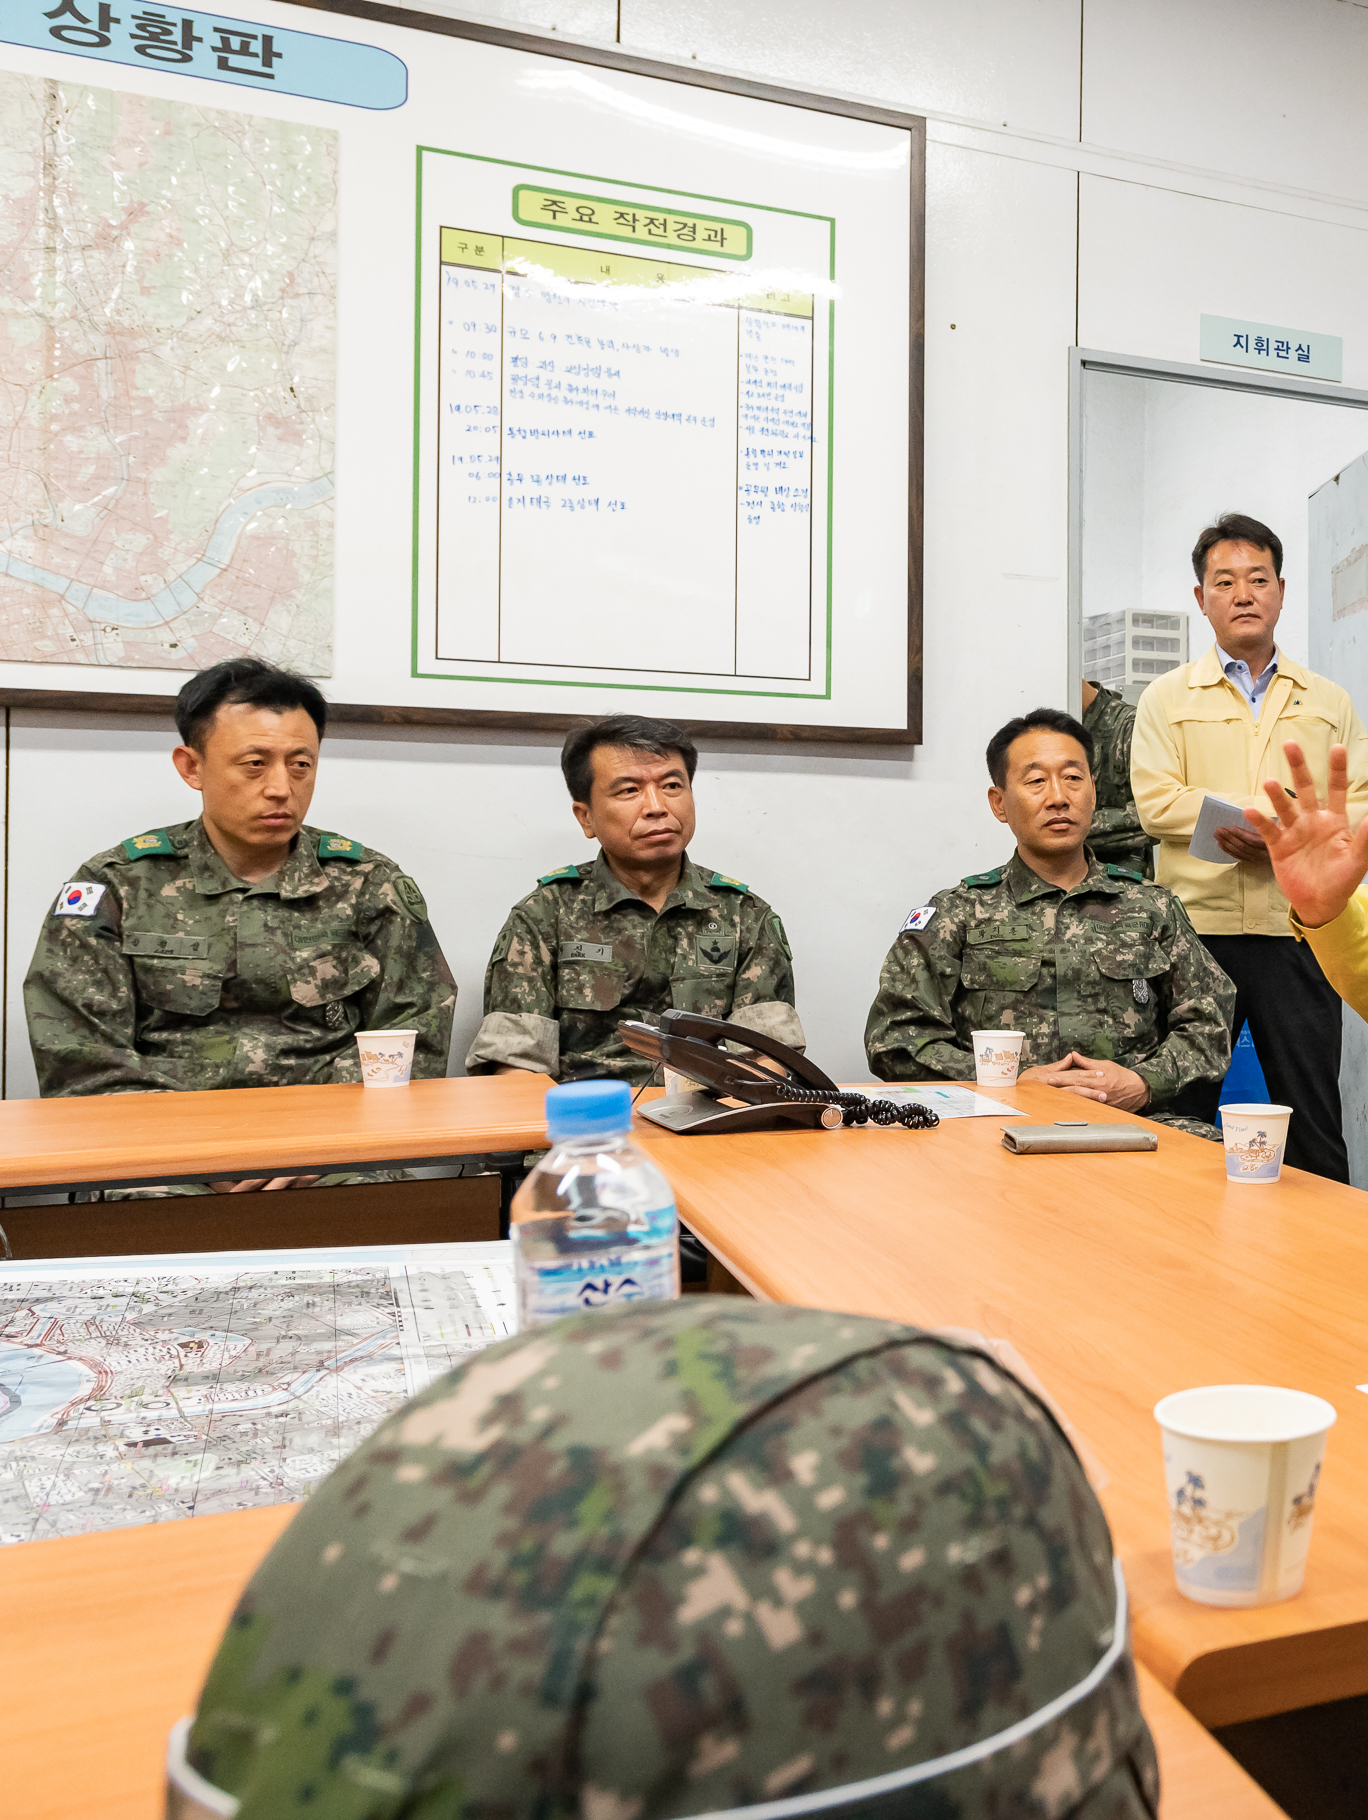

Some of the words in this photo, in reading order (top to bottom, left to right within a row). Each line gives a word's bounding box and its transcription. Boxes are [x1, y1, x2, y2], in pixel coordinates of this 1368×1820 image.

[42, 0, 283, 80] 상황판
[539, 198, 600, 225] 주요
[612, 211, 728, 249] 작전경과
[457, 241, 487, 256] 구분
[600, 265, 610, 276] 내
[463, 321, 498, 334] 09:30
[507, 326, 531, 340] 규모
[621, 342, 652, 354] 사상자
[1233, 333, 1311, 363] 지휘관실
[465, 350, 494, 361] 10:00
[448, 403, 499, 416] 19.05.28
[465, 424, 499, 435] 20:05
[577, 427, 597, 441] 선포
[572, 473, 590, 487] 선포
[606, 499, 628, 513] 선포
